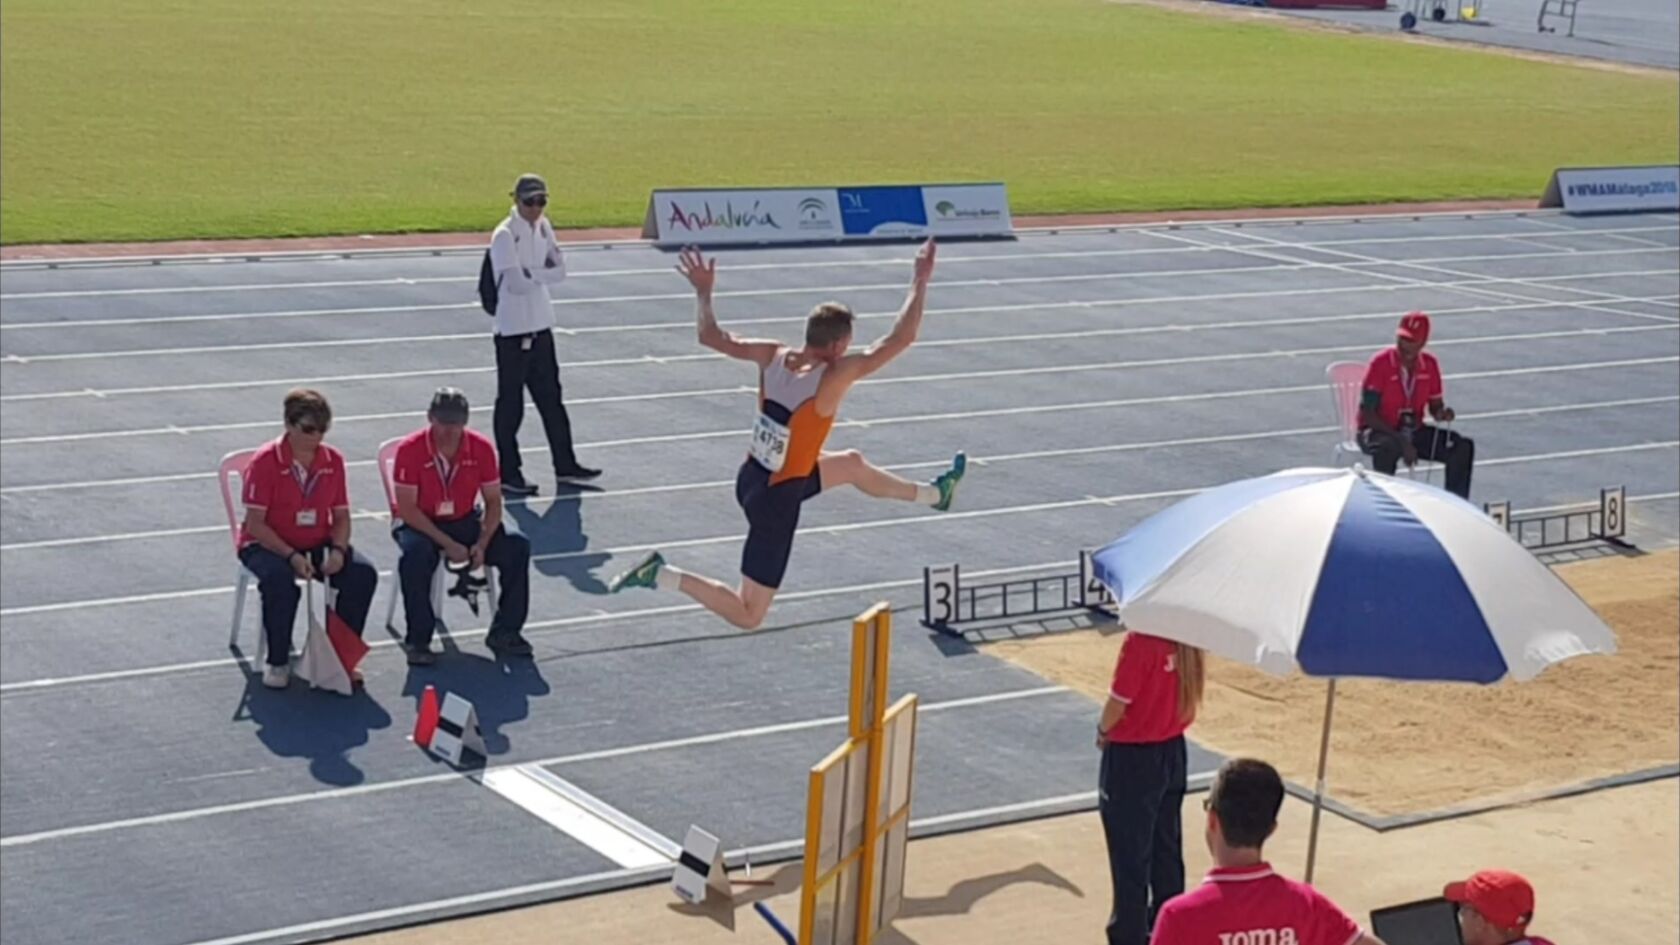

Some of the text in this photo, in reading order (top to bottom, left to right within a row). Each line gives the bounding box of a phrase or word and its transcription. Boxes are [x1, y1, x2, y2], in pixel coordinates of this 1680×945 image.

[1608, 497, 1618, 530] 8
[934, 582, 952, 623] 3
[1087, 577, 1106, 601] 4
